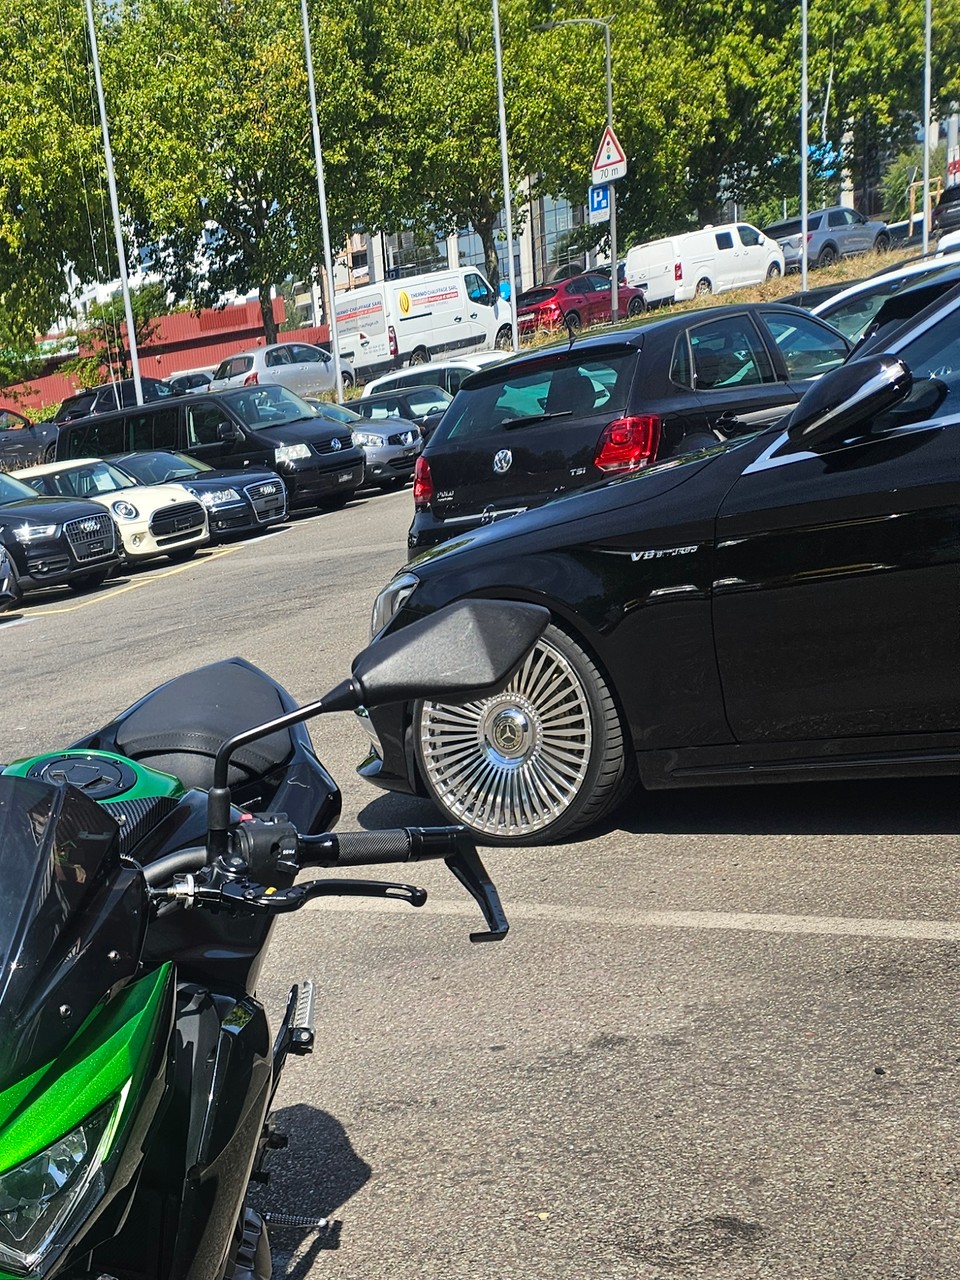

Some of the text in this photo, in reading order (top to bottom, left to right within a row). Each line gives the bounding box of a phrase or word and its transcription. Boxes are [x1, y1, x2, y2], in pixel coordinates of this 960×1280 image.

[600, 167, 618, 179] 70 m
[631, 550, 656, 562] V8
